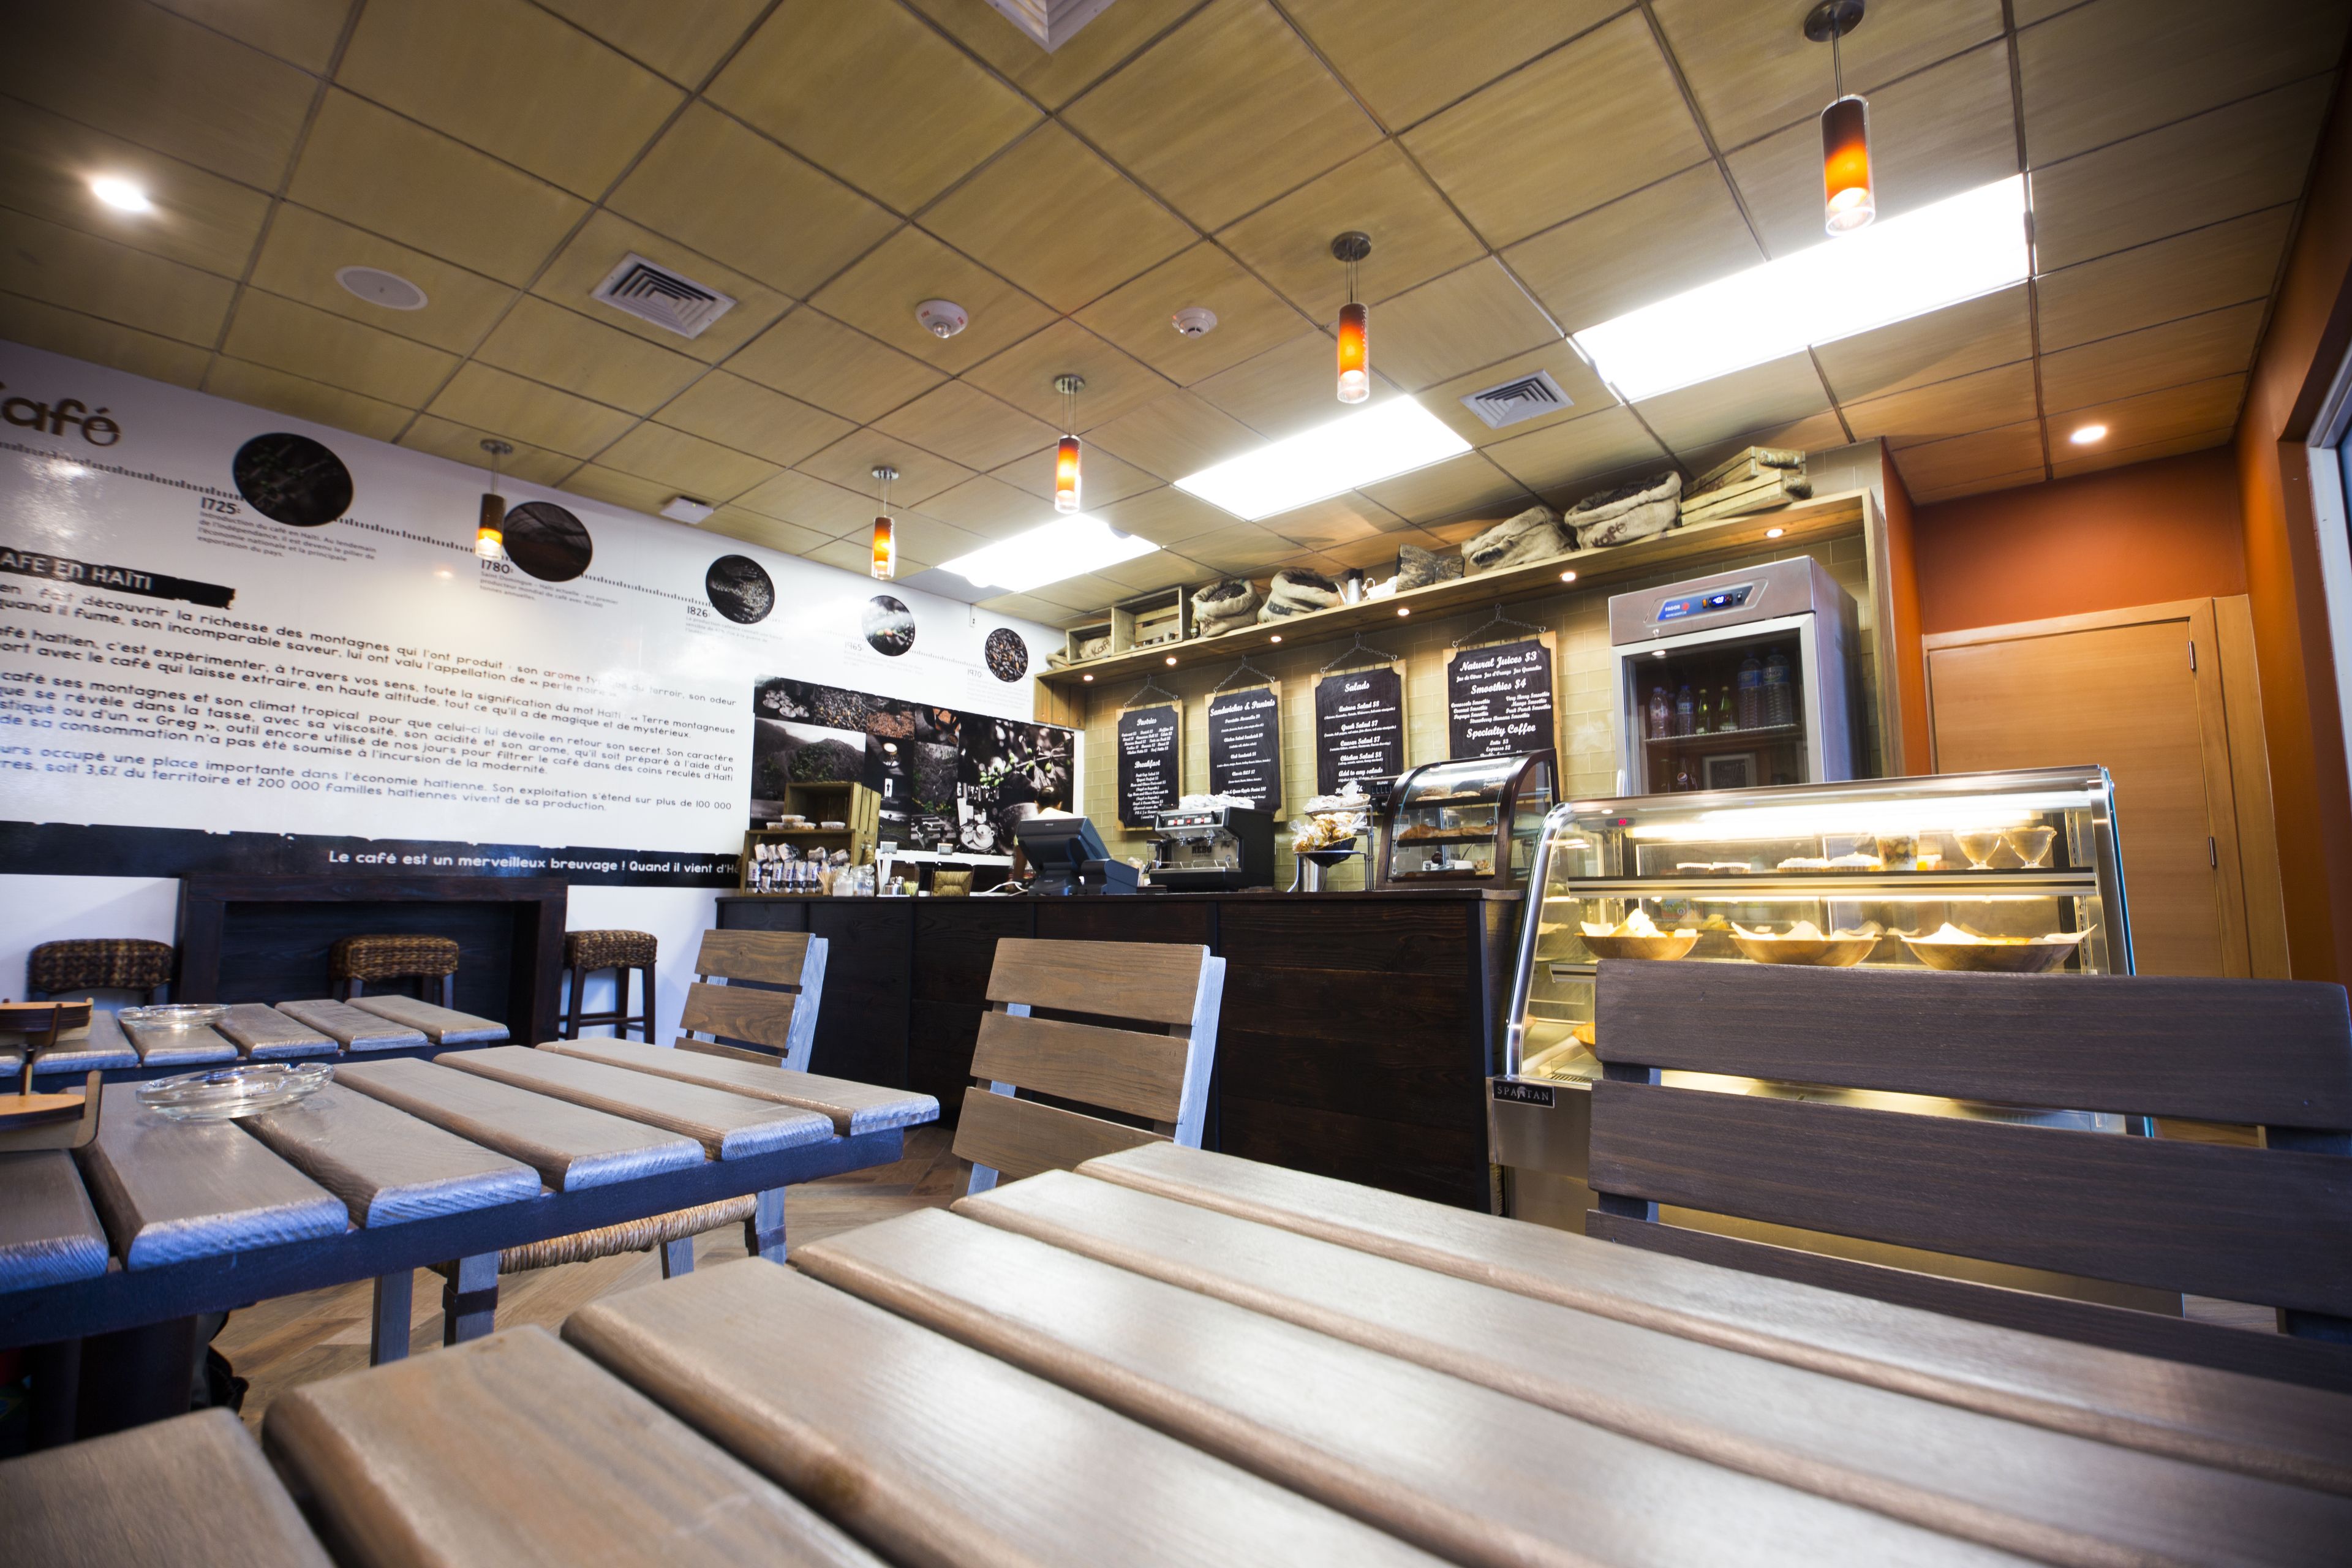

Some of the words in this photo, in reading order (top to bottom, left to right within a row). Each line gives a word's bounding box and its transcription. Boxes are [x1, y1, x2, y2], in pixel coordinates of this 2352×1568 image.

[0, 380, 121, 447] afé
[1460, 658, 1494, 671] Natural
[1496, 655, 1522, 668] Juices
[1525, 651, 1537, 662] $3
[37, 648, 81, 660] avec
[88, 652, 103, 663] le
[110, 657, 150, 669] café
[157, 664, 183, 674] qui
[188, 665, 235, 680] laisse
[241, 674, 309, 690] extraire,
[339, 685, 379, 698] haute
[384, 693, 439, 705] altitude,
[445, 699, 469, 709] tout
[551, 715, 598, 726] magique
[633, 726, 691, 737] mystérieux.
[1344, 680, 1370, 693] Salads
[1471, 682, 1512, 695] Smoothies
[1515, 678, 1526, 690] $4
[1, 673, 45, 684] café
[52, 678, 83, 688] ses
[90, 683, 186, 700] montagnes
[193, 694, 208, 703] et
[215, 697, 243, 707] son
[249, 700, 295, 712] climat
[302, 706, 359, 720] tropical
[368, 715, 402, 724] pour
[407, 720, 432, 729] que
[437, 723, 480, 734] celui-ci
[484, 726, 498, 736] lui
[502, 730, 545, 741] dévoile
[567, 738, 601, 747] retour
[1210, 704, 1243, 717] Sandwiches
[1251, 699, 1275, 709] Paninis
[1137, 718, 1157, 726] Pastries
[1466, 725, 1506, 740] Specialty
[1507, 723, 1536, 735] Coffee
[0, 715, 23, 725] de
[30, 719, 52, 728] sa
[59, 722, 188, 741] consommation
[195, 734, 220, 744] n'a
[226, 738, 255, 747] pas
[262, 741, 287, 750] été
[293, 744, 352, 756] soumise
[372, 750, 440, 764] l'incursion
[466, 759, 477, 767] la
[482, 763, 548, 774] modernité.
[1134, 759, 1161, 769] Breakfast
[45, 764, 78, 773] soit
[123, 768, 145, 778] du
[152, 770, 230, 784] territoire
[236, 777, 251, 785] et
[257, 778, 285, 788] 200
[290, 780, 320, 791] 000
[325, 783, 382, 795] familles
[388, 788, 457, 800] haïtiennes
[543, 801, 607, 810] production.
[328, 850, 349, 862] Le
[355, 852, 396, 864] café
[402, 853, 428, 865] est
[432, 857, 453, 865] un
[458, 856, 546, 868] merveilleux
[550, 858, 617, 873] breuvage
[621, 861, 625, 870] !
[628, 861, 670, 872] Quand
[673, 862, 680, 872] il
[684, 863, 712, 873] vient
